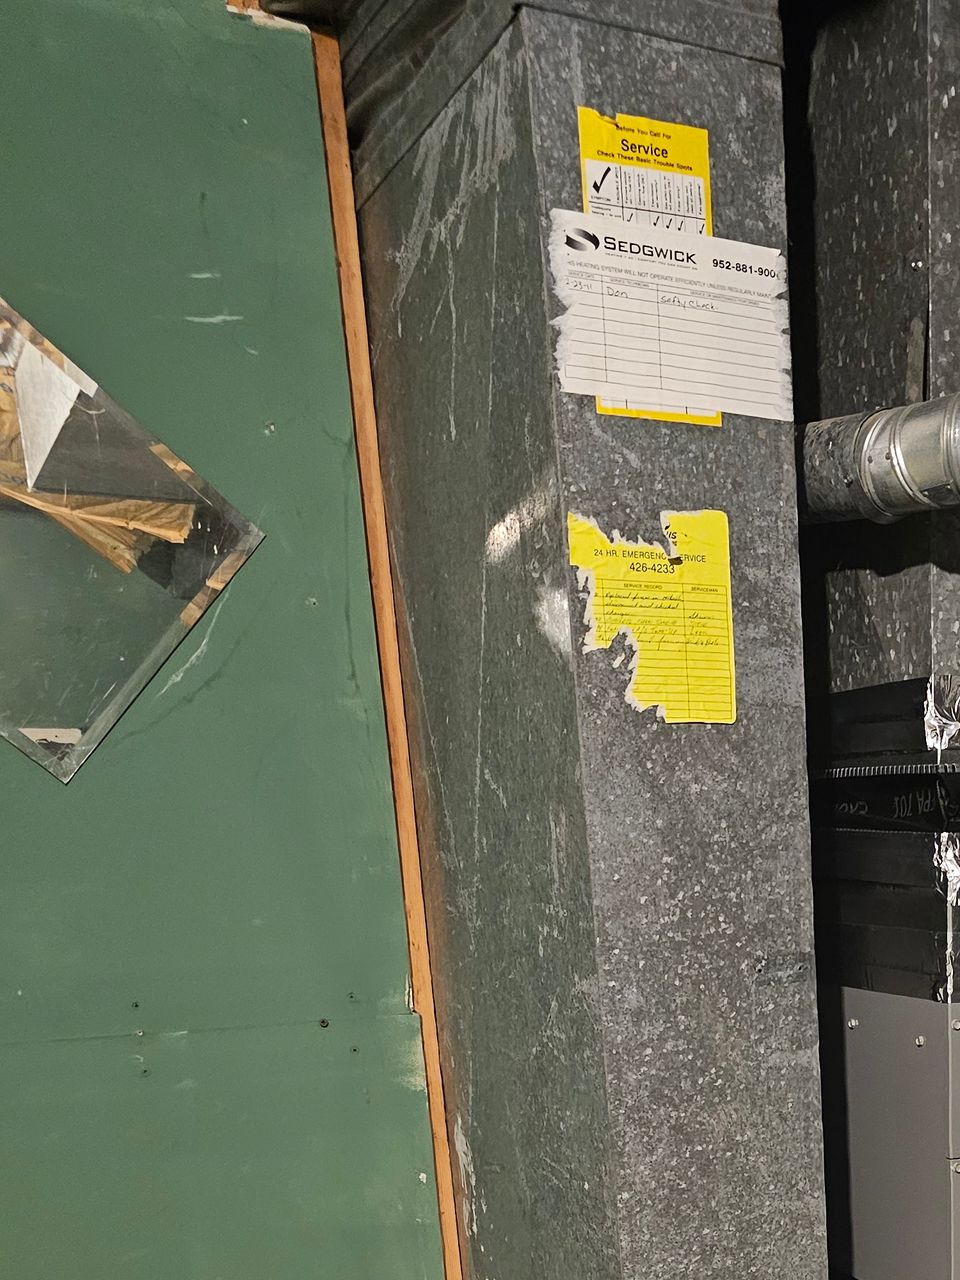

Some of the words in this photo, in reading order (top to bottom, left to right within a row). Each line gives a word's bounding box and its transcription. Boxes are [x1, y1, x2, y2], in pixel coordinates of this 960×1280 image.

[621, 138, 668, 158] Service
[654, 159, 674, 167] Trouble
[676, 163, 692, 171] Spots
[604, 236, 696, 264] SEDGWICK
[576, 262, 599, 270] HEATING
[601, 265, 622, 273] SYSTEM
[650, 273, 673, 281] OPERATE
[622, 550, 666, 560] EMERGENC
[680, 554, 706, 563] ERVICE
[629, 562, 675, 574] 426-4233
